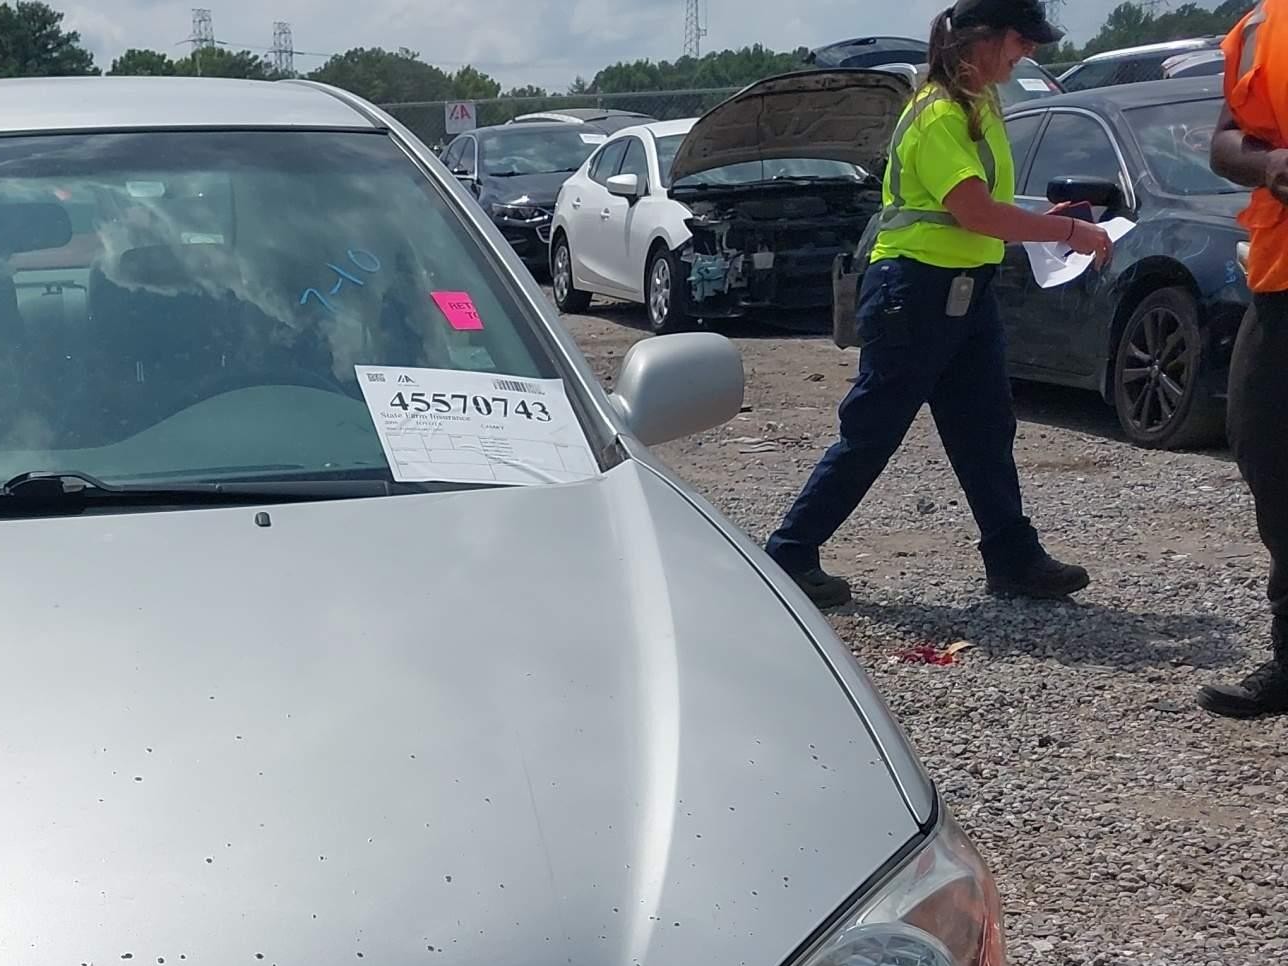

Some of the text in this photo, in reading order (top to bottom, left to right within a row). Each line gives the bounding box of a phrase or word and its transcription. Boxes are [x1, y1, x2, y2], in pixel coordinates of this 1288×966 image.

[380, 411, 402, 419] State
[429, 413, 471, 421] Insurance
[389, 391, 552, 422] 45570743
